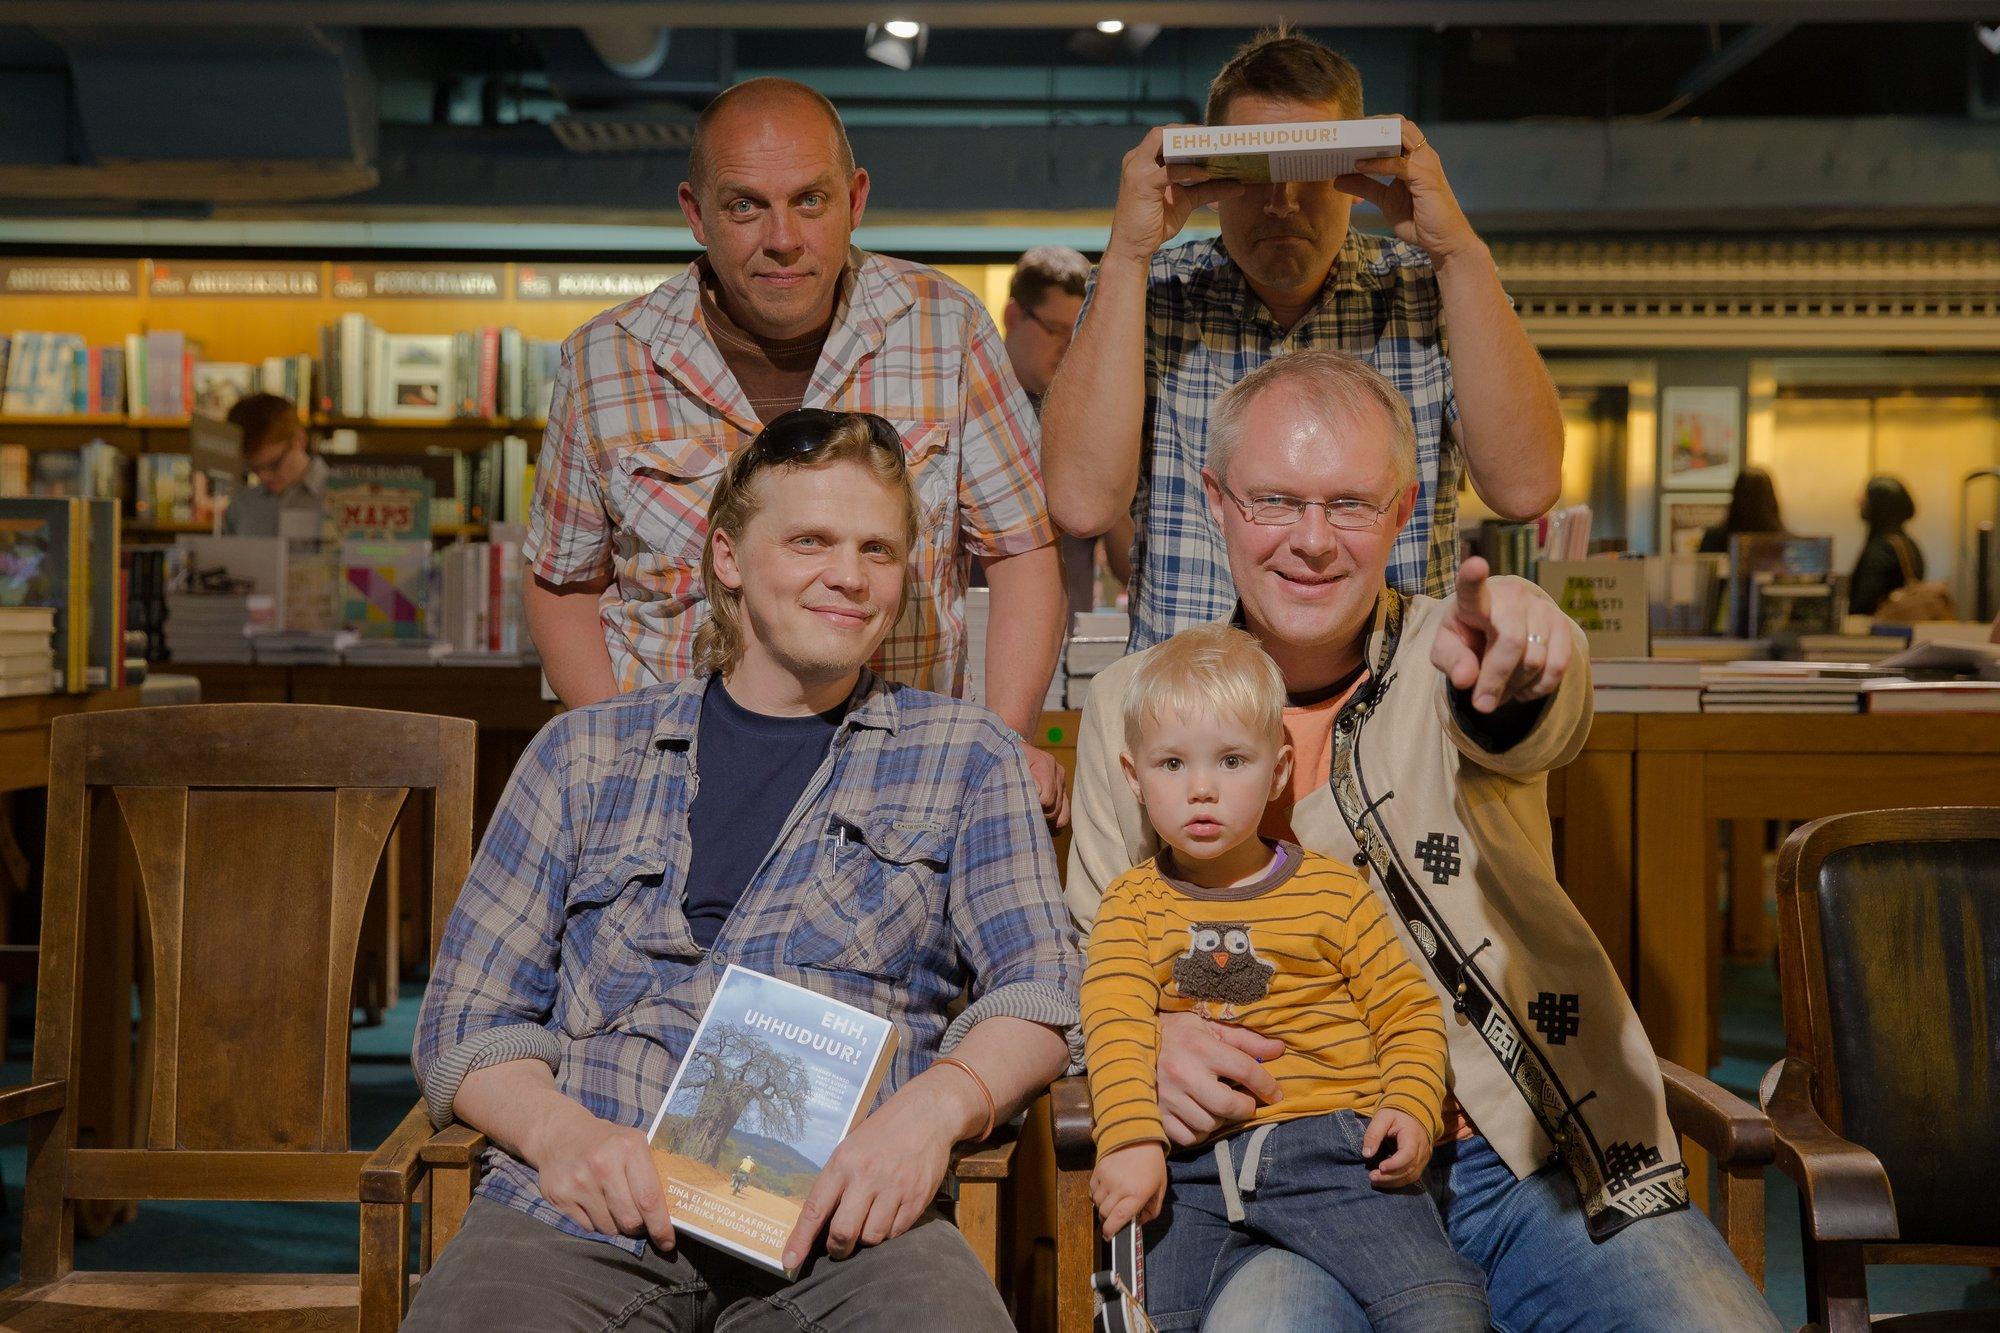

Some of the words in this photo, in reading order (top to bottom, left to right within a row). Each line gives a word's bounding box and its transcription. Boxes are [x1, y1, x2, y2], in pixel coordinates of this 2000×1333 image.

[340, 505, 411, 529] MAPS
[744, 1008, 861, 1065] UHHUDUUR!
[821, 1010, 867, 1046] EHH,
[667, 1184, 689, 1200] SINA
[691, 1194, 701, 1204] EI
[703, 1199, 736, 1219] MUUDA
[737, 1214, 786, 1241] AAFRIKAT,
[676, 1200, 715, 1220] AAFRIKA
[717, 1217, 757, 1238] MUUDAB
[760, 1233, 784, 1248] SIND
